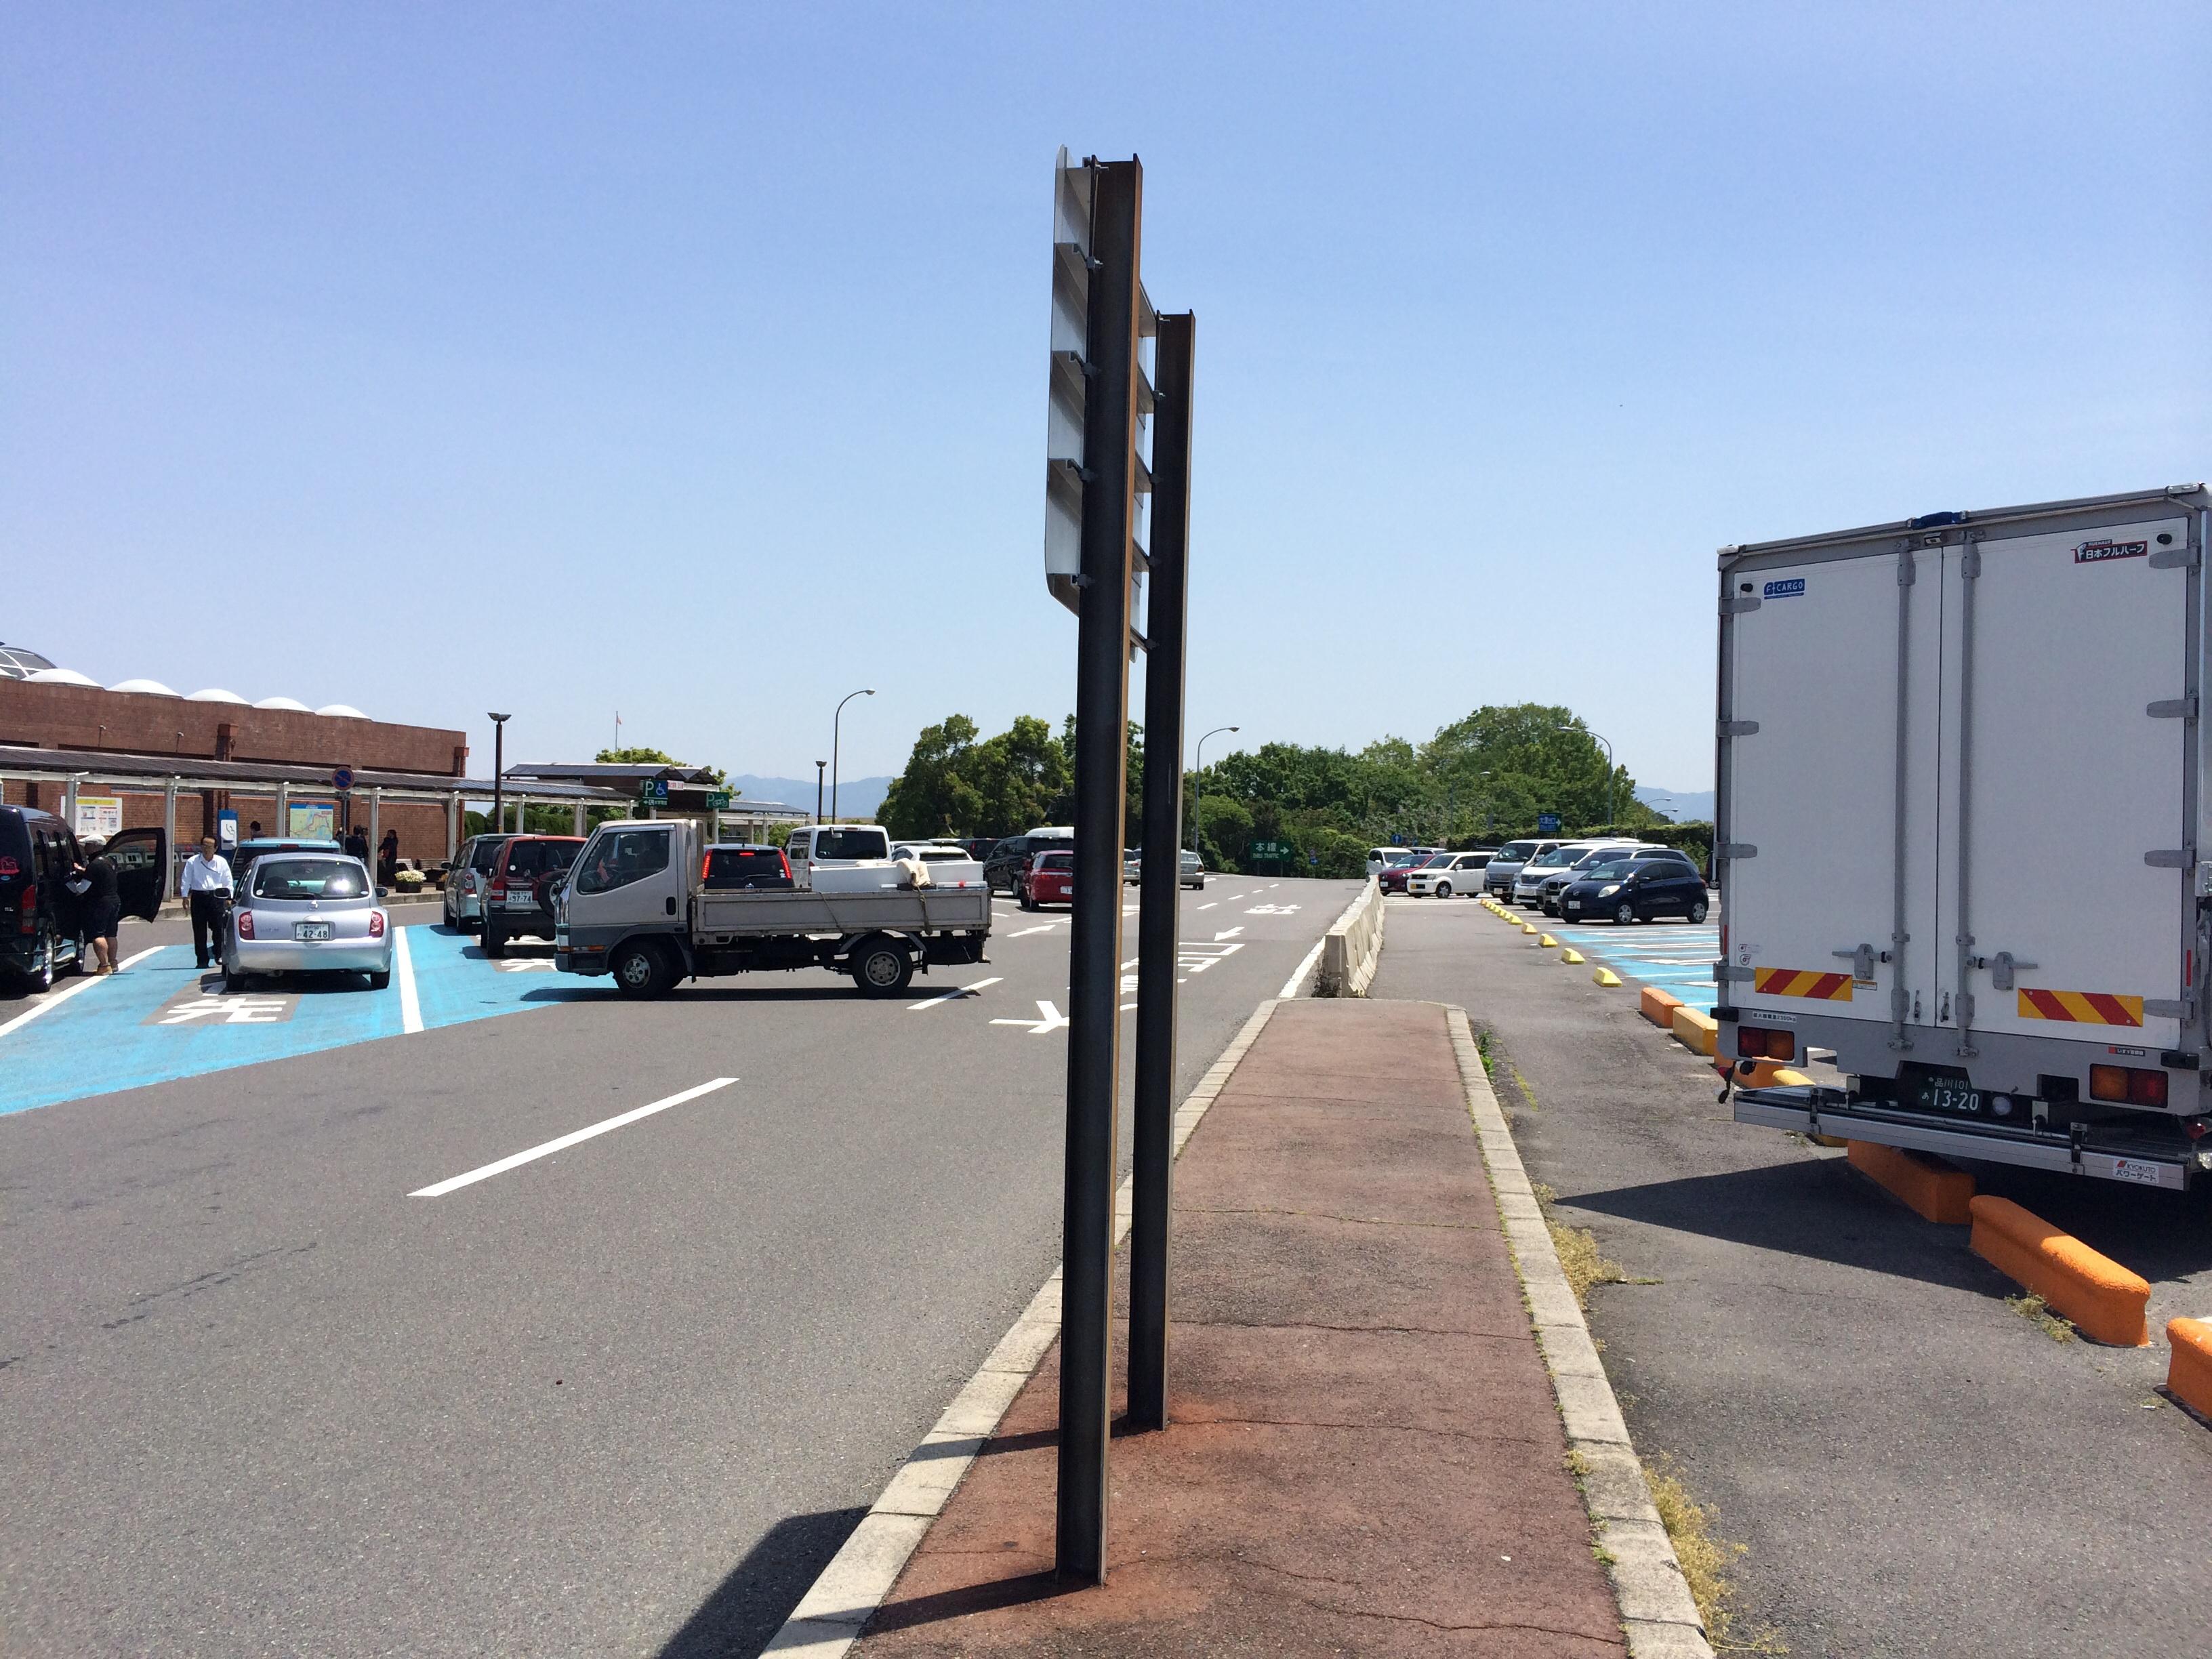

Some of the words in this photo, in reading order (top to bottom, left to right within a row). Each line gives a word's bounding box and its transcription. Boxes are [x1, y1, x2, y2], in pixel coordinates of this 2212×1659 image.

[2086, 544, 2145, 560] 日本フルハーフ
[645, 781, 655, 796] P
[706, 792, 715, 807] P
[512, 895, 531, 903] 97-74
[303, 930, 328, 939] 42-48
[1934, 1078, 1968, 1090] 品川101
[1921, 1091, 1929, 1100] あ
[1933, 1088, 1979, 1111] 13-20
[2127, 1164, 2156, 1173] KYOKUTO
[2115, 1169, 2156, 1181] パワーゲート
